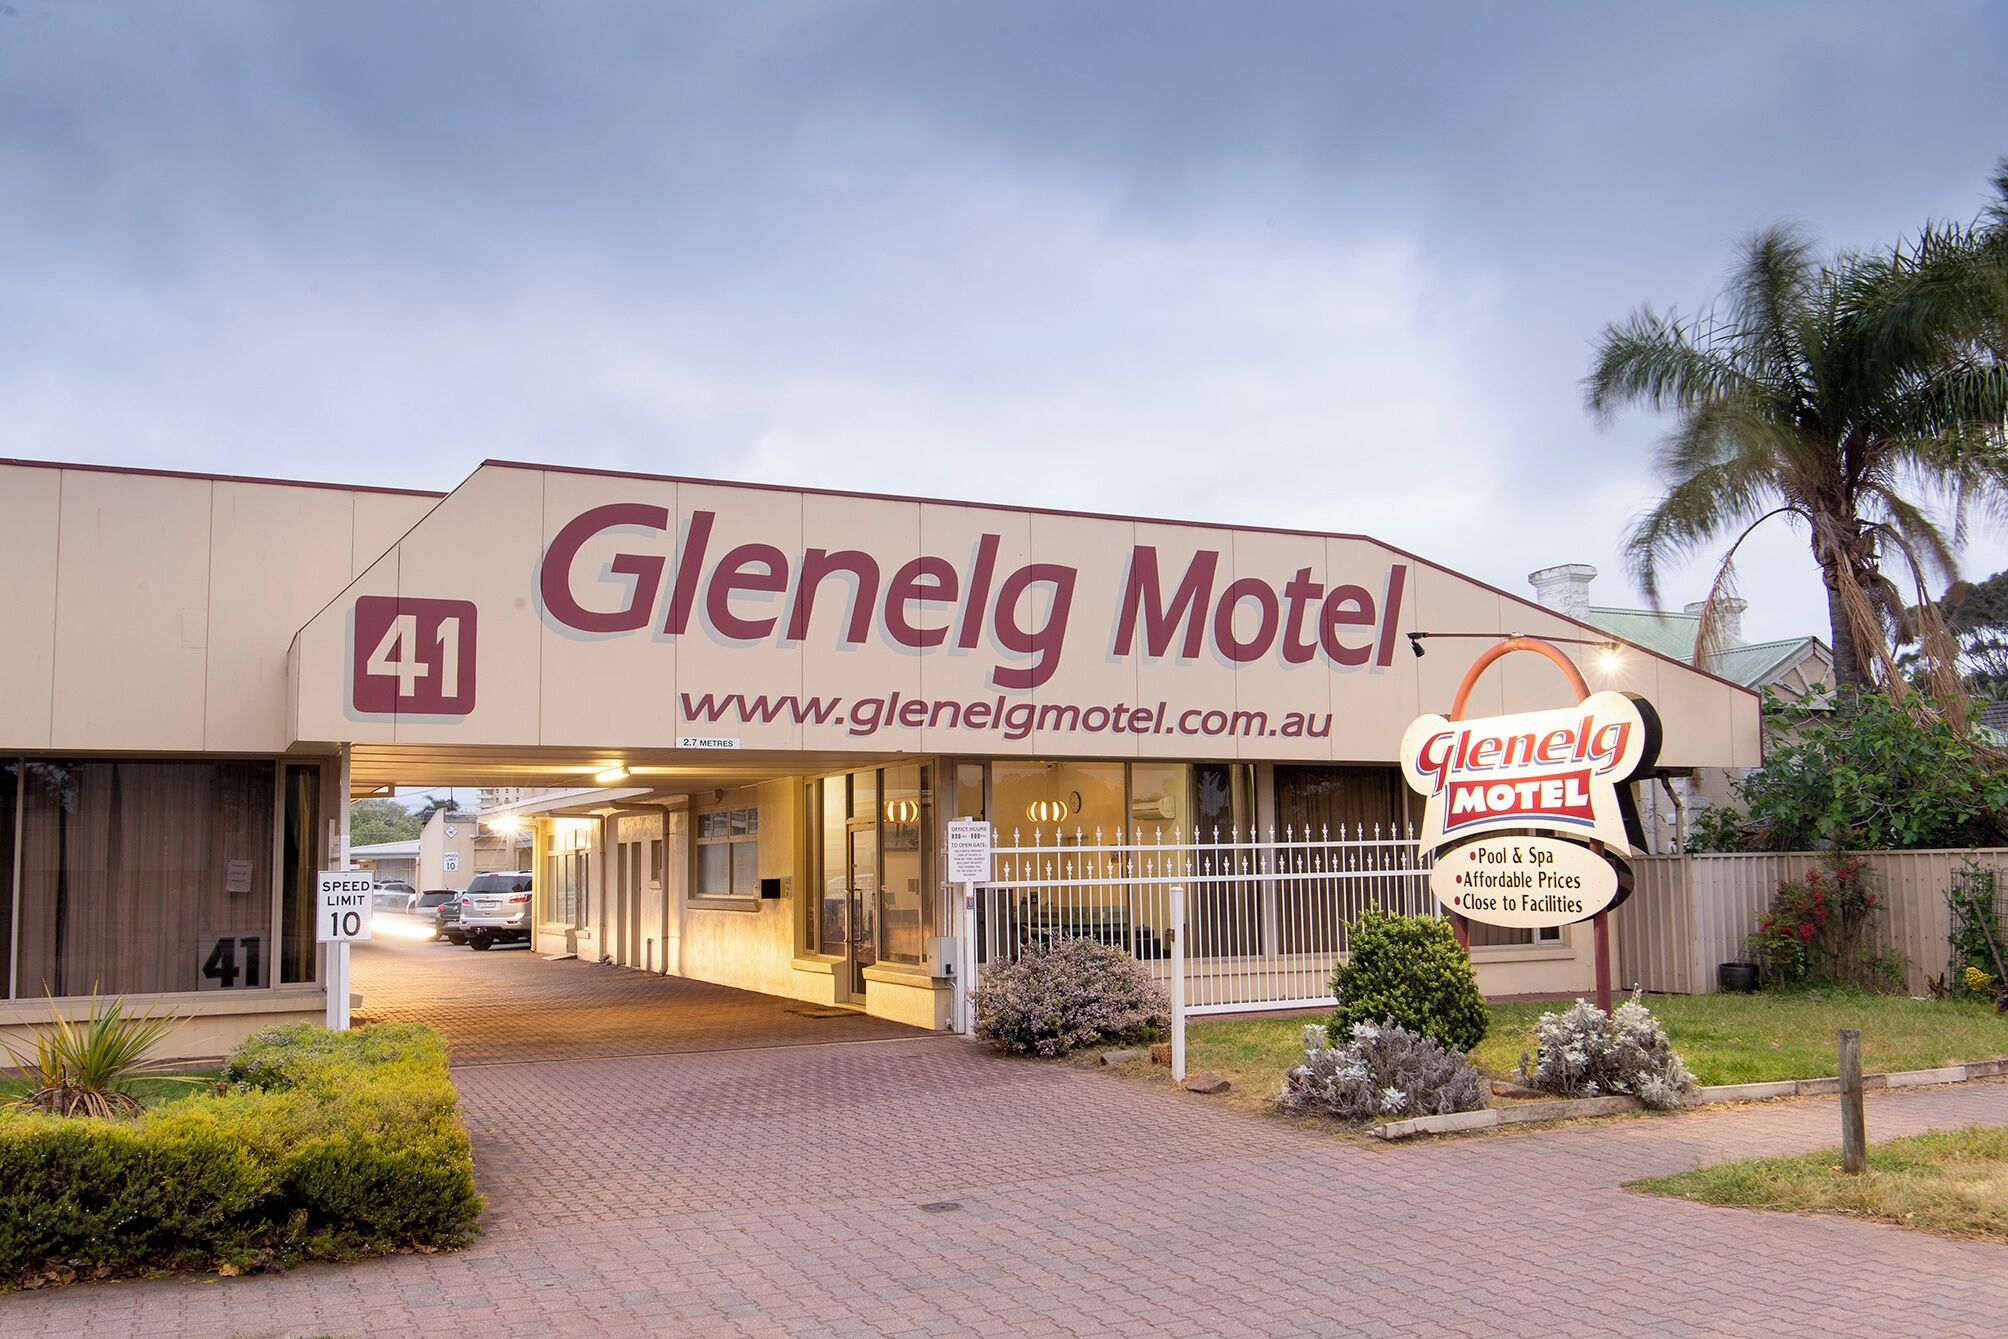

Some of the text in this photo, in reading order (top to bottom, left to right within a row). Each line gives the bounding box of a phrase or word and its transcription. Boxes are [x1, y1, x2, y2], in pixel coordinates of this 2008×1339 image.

[539, 502, 1408, 690] Glenelg Motel
[366, 614, 460, 698] 41
[680, 691, 1333, 740] www.glenelgmotel.com.au
[683, 738, 697, 746] 2.7
[1417, 714, 1632, 796] Glenelg
[1451, 778, 1589, 814] MOTEL
[1478, 847, 1554, 868] Pool & Spa
[322, 881, 370, 892] SPEED
[1463, 871, 1581, 889] Affordable Prices
[327, 895, 365, 906] LIMIT
[1463, 893, 1583, 913] Close to Facilities
[331, 911, 361, 937] 10
[202, 936, 261, 987] 41
